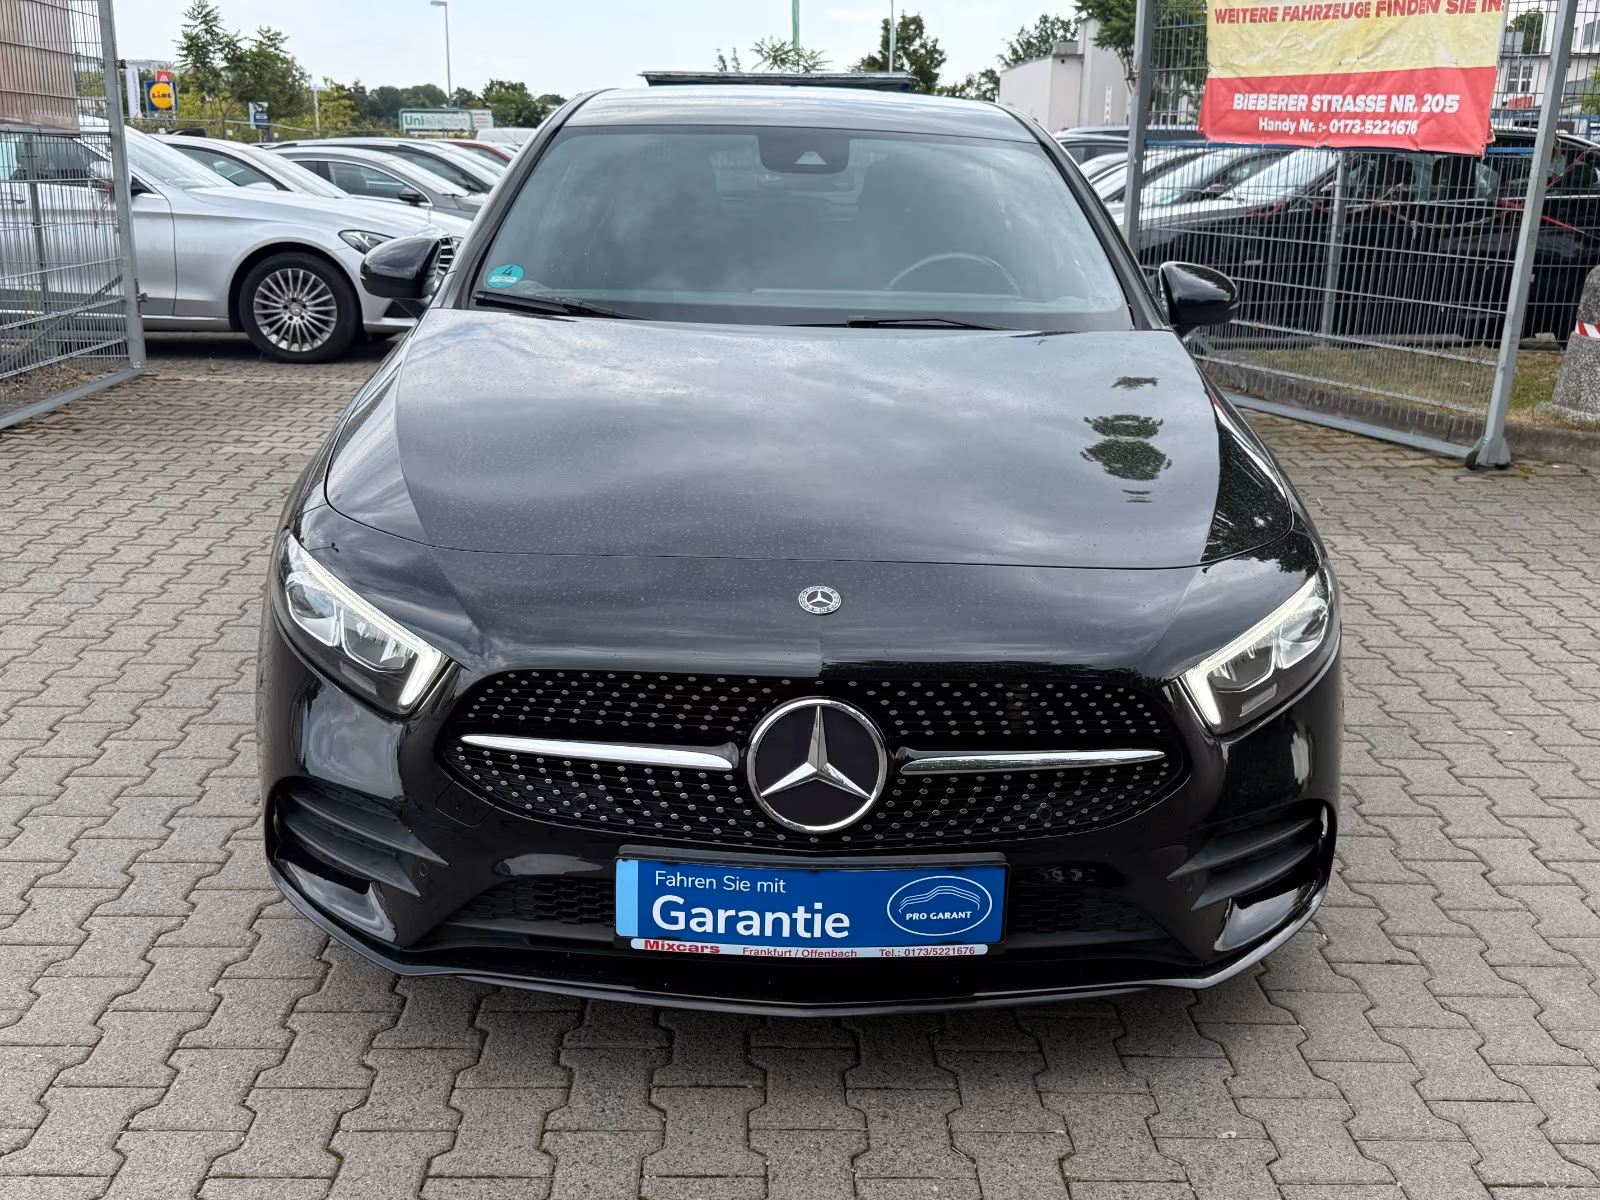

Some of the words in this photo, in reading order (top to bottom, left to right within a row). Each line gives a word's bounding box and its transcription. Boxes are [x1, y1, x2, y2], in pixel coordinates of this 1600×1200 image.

[1214, 6, 1279, 24] WEITERE
[1281, 1, 1371, 22] FAHRZEUGE
[1375, 0, 1440, 17] FINDEN
[1445, 0, 1477, 14] SIE
[1232, 93, 1309, 112] BIEBERER
[1310, 94, 1387, 113] STRASSE
[1389, 94, 1418, 113] NR.
[1421, 94, 1461, 114] 205
[1258, 117, 1297, 135] Handy
[1299, 118, 1316, 133] Nr.
[1329, 119, 1419, 135] 0173-5221676
[655, 870, 717, 890] Fahren
[722, 875, 751, 892] Sie
[757, 877, 787, 894] mit
[652, 894, 851, 939] Garantie
[905, 912, 928, 921] PRO
[929, 911, 973, 920] GARANT
[644, 939, 721, 954] Mixcars
[742, 946, 793, 957] Frankfurt
[801, 948, 857, 959] Offenbach
[879, 948, 901, 958] Tel.:
[904, 946, 975, 957] 0173/5221676
